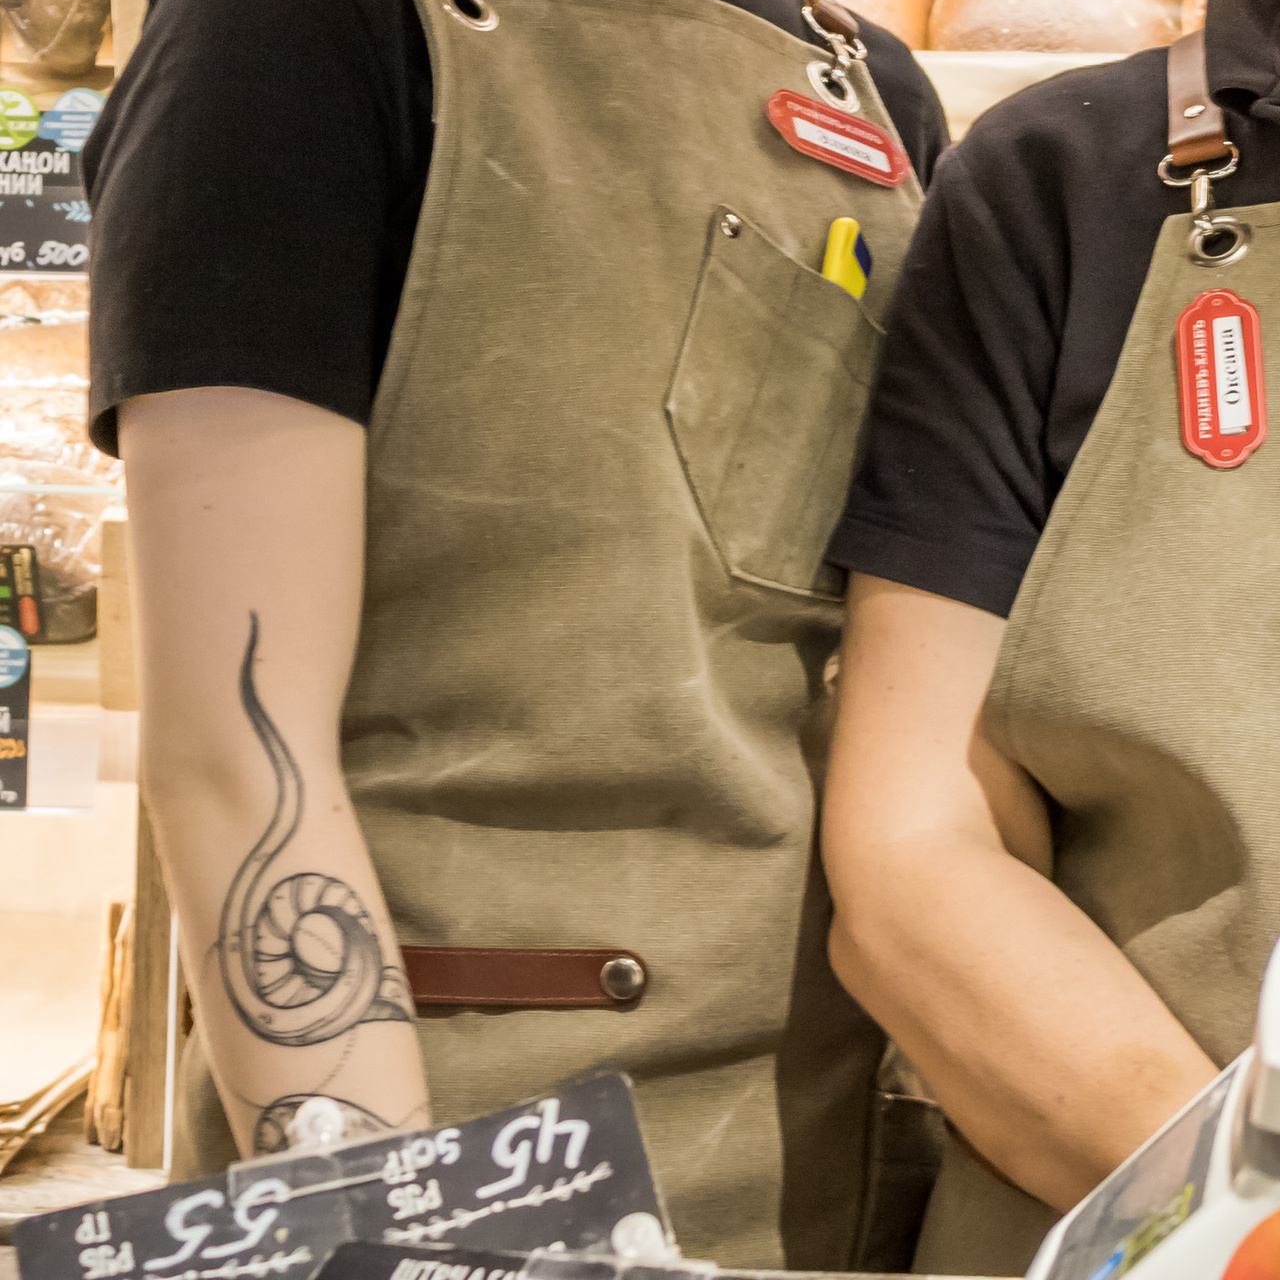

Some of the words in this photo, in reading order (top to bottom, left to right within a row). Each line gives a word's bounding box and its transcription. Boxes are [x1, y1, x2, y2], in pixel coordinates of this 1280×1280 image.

[36, 240, 90, 266] 500
[1221, 329, 1241, 405] Оксана
[475, 1097, 591, 1200] 45
[74, 1210, 112, 1245] ГР
[142, 1177, 291, 1272] 55
